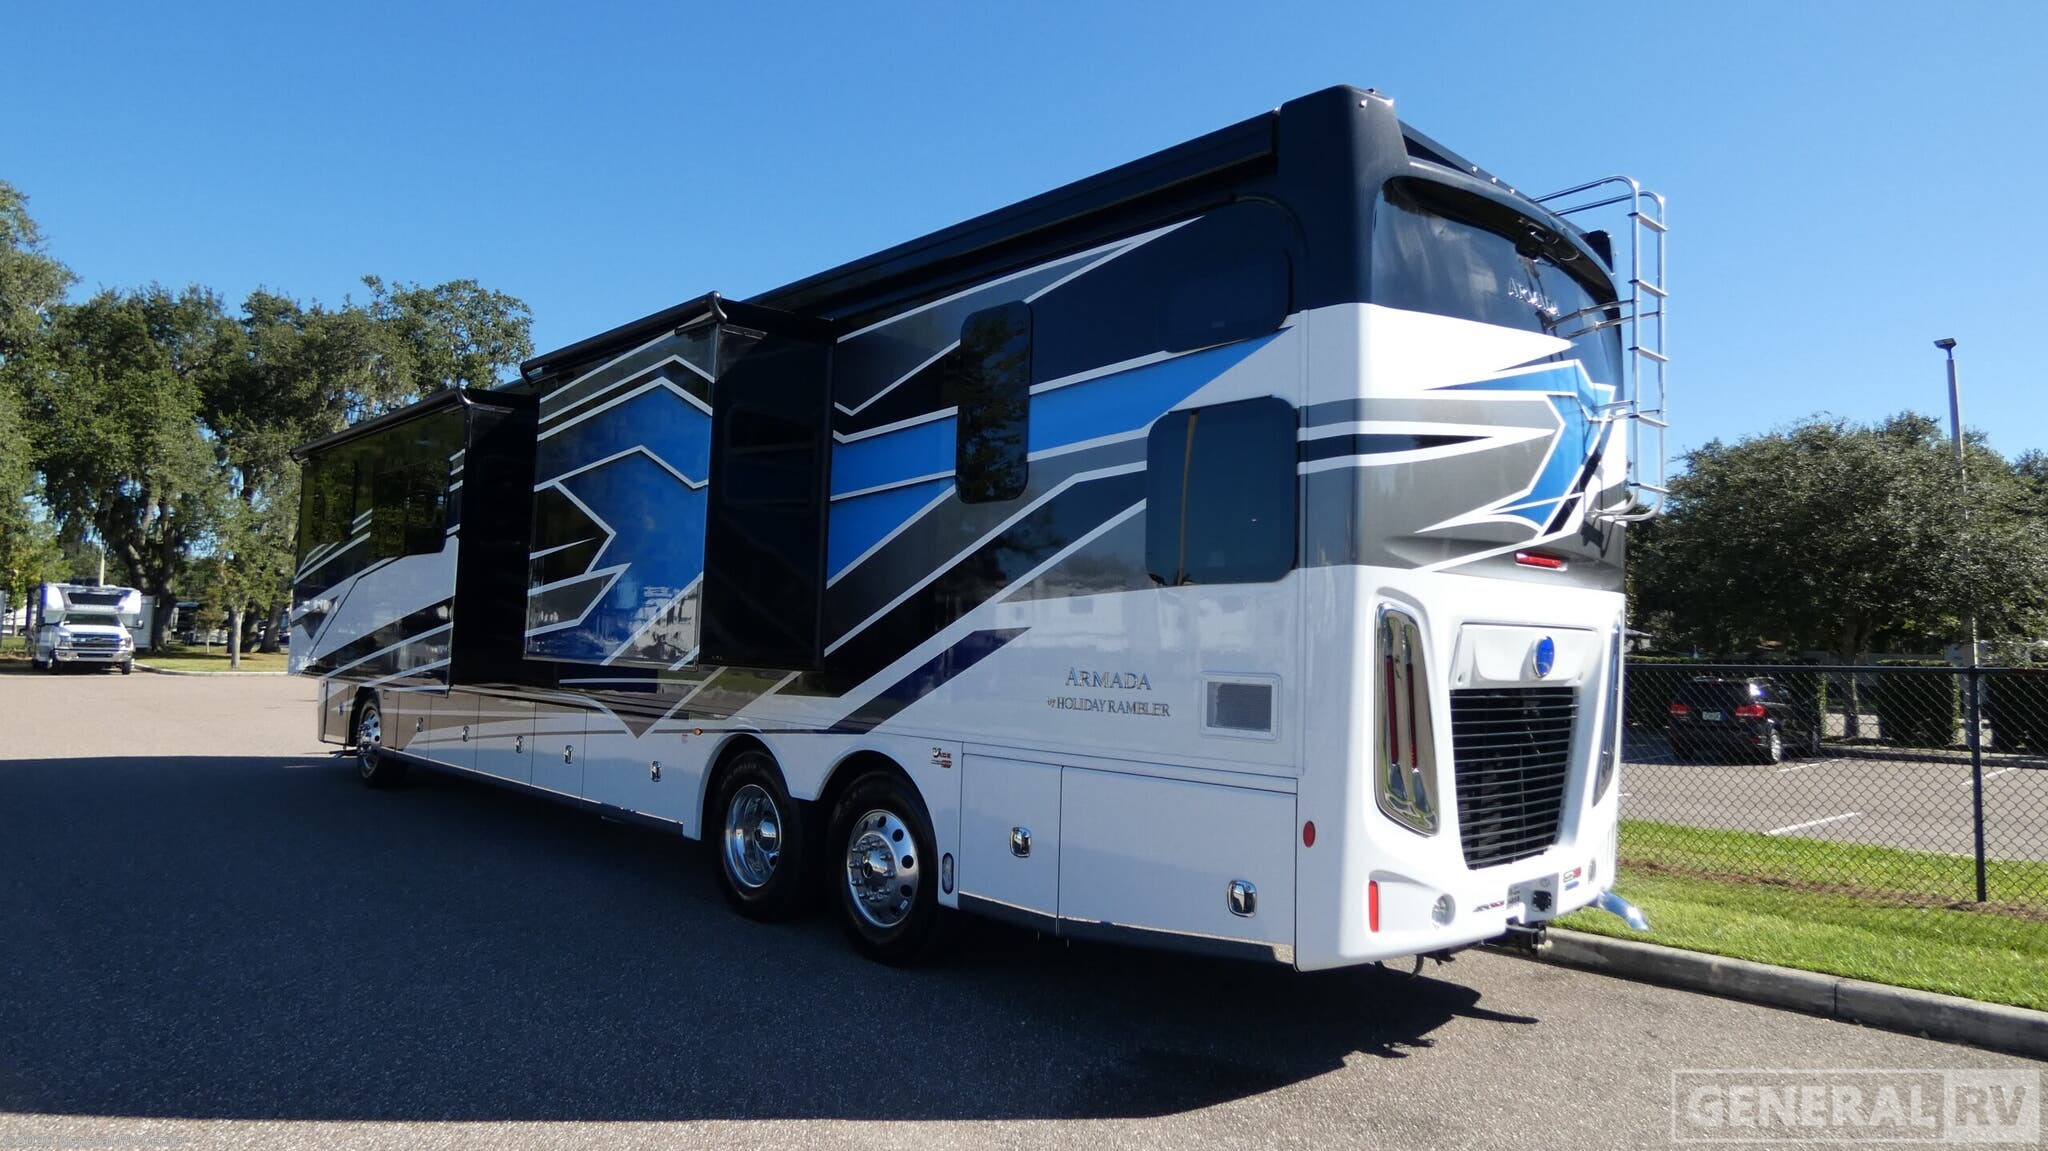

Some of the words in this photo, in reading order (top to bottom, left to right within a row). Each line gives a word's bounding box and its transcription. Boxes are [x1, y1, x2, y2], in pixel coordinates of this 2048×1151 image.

[1065, 666, 1152, 691] ARMADA
[1057, 697, 1107, 713] HOLIDAY
[1107, 699, 1171, 717] RAMBLER
